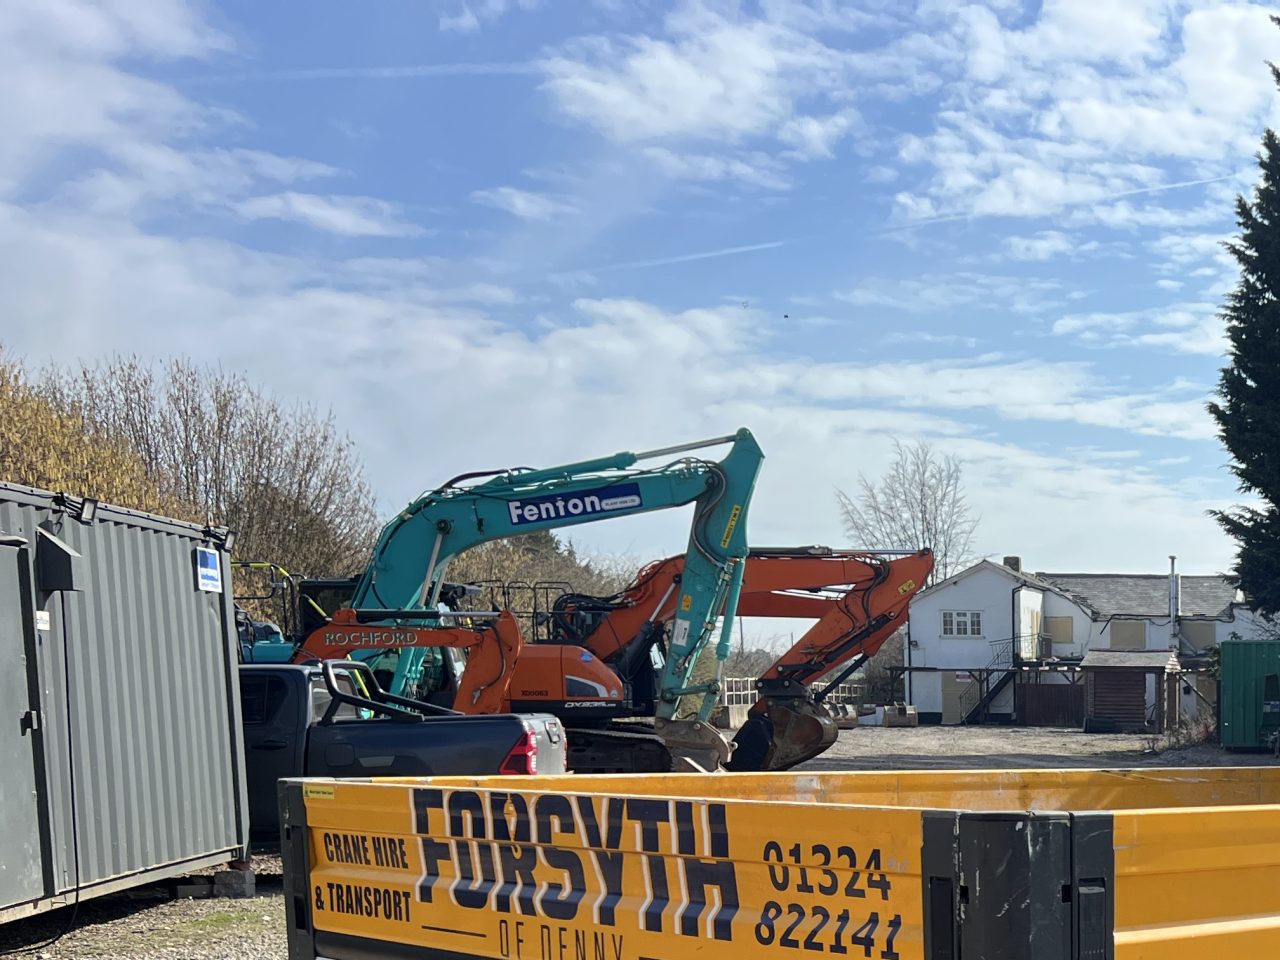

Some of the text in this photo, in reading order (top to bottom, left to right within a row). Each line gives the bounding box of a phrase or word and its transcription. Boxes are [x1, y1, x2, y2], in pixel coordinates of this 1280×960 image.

[508, 495, 601, 524] Fenton
[324, 632, 418, 646] ROCHFORD
[323, 832, 410, 870] CRANE HIRE
[409, 787, 740, 942] FORSYTH
[763, 840, 892, 901] 01324
[315, 882, 412, 923] & TRANSPORT
[500, 919, 524, 960] OF
[754, 900, 902, 960] 822141
